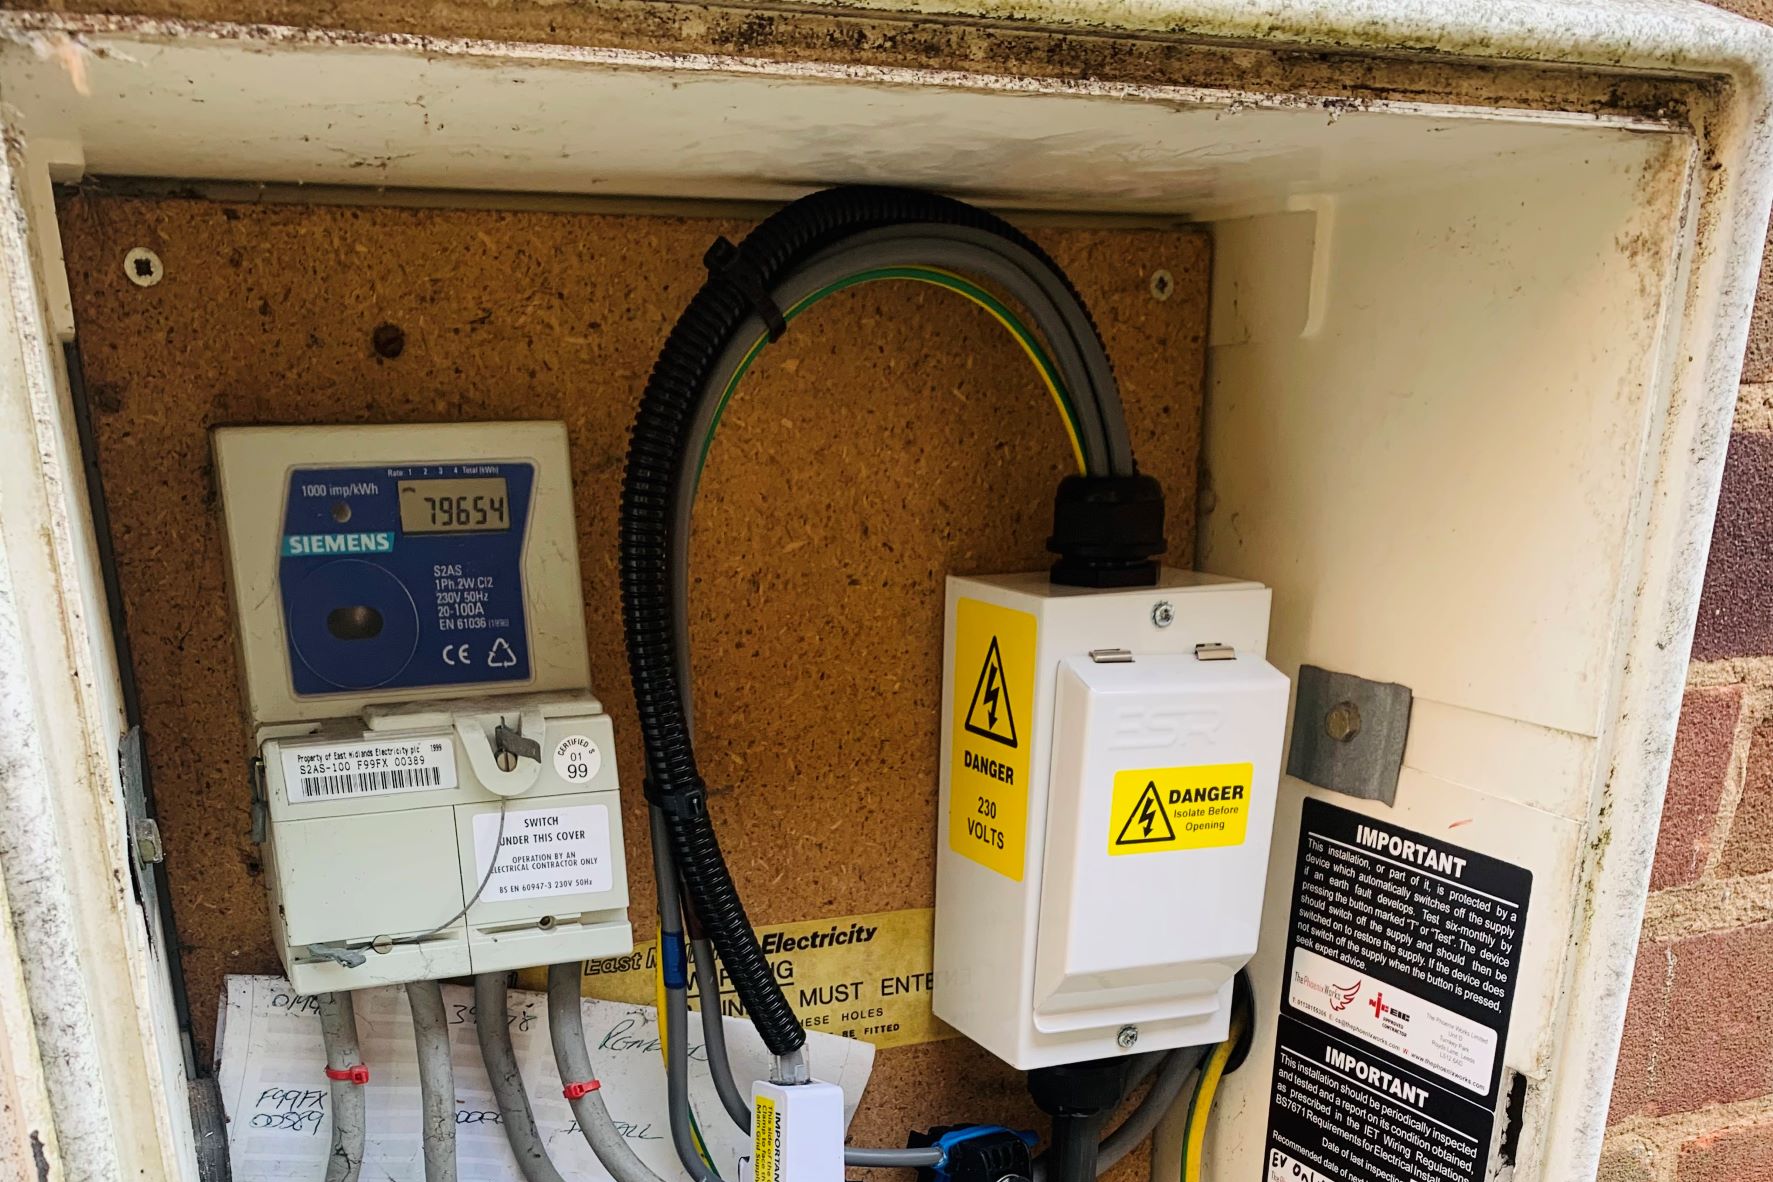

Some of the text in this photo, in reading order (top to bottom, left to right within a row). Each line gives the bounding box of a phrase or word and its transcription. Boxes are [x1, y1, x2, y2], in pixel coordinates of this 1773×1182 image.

[423, 467, 428, 475] 2
[438, 467, 443, 475] 3
[453, 466, 458, 474] 4
[301, 482, 379, 498] 1000 imp/kWh
[423, 496, 504, 527] 79654
[288, 533, 390, 554] SIEMENS
[433, 564, 462, 577] S2AS
[464, 590, 489, 602] 50Hz
[437, 602, 485, 617] 20-100A
[439, 619, 455, 631] EN
[457, 617, 487, 630] 61036
[1109, 705, 1223, 751] ESR
[297, 753, 323, 763] Property
[324, 752, 332, 761] of
[333, 751, 347, 760] East
[348, 749, 374, 759] Midlands
[375, 746, 409, 758] Electricity
[410, 746, 420, 755] plc
[557, 738, 589, 756] CERTIFIED
[299, 755, 425, 775] S2AS-100 F99FX 00389
[570, 752, 582, 762] 01
[567, 763, 588, 779] 99
[963, 750, 1014, 786] DANGER
[1168, 785, 1244, 804] DANGER
[977, 795, 997, 820] 230
[1174, 805, 1239, 819] Isolate Before
[524, 816, 559, 828] SWITCH
[1185, 820, 1225, 833] Opening
[500, 830, 586, 846] UNDER THIS COVER
[967, 817, 1005, 850] VOLTS
[512, 851, 576, 864] OPERATION BY AN
[1356, 824, 1466, 877] IMPORTANT
[531, 859, 578, 871] CONTRACTOR
[580, 857, 598, 866] ONLY
[499, 886, 508, 894] BS
[510, 884, 520, 893] EN
[522, 881, 552, 892] 60947-3
[554, 880, 573, 889] 230V
[1308, 837, 1517, 922] This installation, or part of it, is protected by a
[1305, 853, 1515, 939] device which automatically switches off the supply
[584, 951, 642, 976] East
[761, 922, 878, 954] Electricity
[1295, 934, 1367, 970] seek expert advice.
[799, 981, 864, 1007] MUST
[841, 1007, 884, 1022] HOLES
[864, 1023, 900, 1035] FITTED
[1325, 1046, 1428, 1107] IMPORTANT
[1280, 1051, 1478, 1159] This installation should be periodically inspected
[1276, 1081, 1286, 1093] as
[1289, 1088, 1331, 1115] prescribed
[1334, 1108, 1342, 1122] in
[1346, 1115, 1360, 1130] the
[1363, 1123, 1380, 1140] IET
[1382, 1133, 1411, 1159] Wiring
[1277, 1068, 1474, 1175] and tested and a report on its condition obtained,
[1275, 1092, 1305, 1117] BS7671
[1305, 1108, 1362, 1146] Requirements
[1361, 1137, 1374, 1152] for
[1373, 1143, 1414, 1173] Electrical
[1271, 1151, 1288, 1168] EV
[1272, 1129, 1322, 1164] Recommended
[1322, 1158, 1339, 1173] date
[1339, 1168, 1348, 1178] of
[1321, 1136, 1340, 1154] Date
[1340, 1148, 1350, 1159] of
[1349, 1151, 1364, 1167] last
